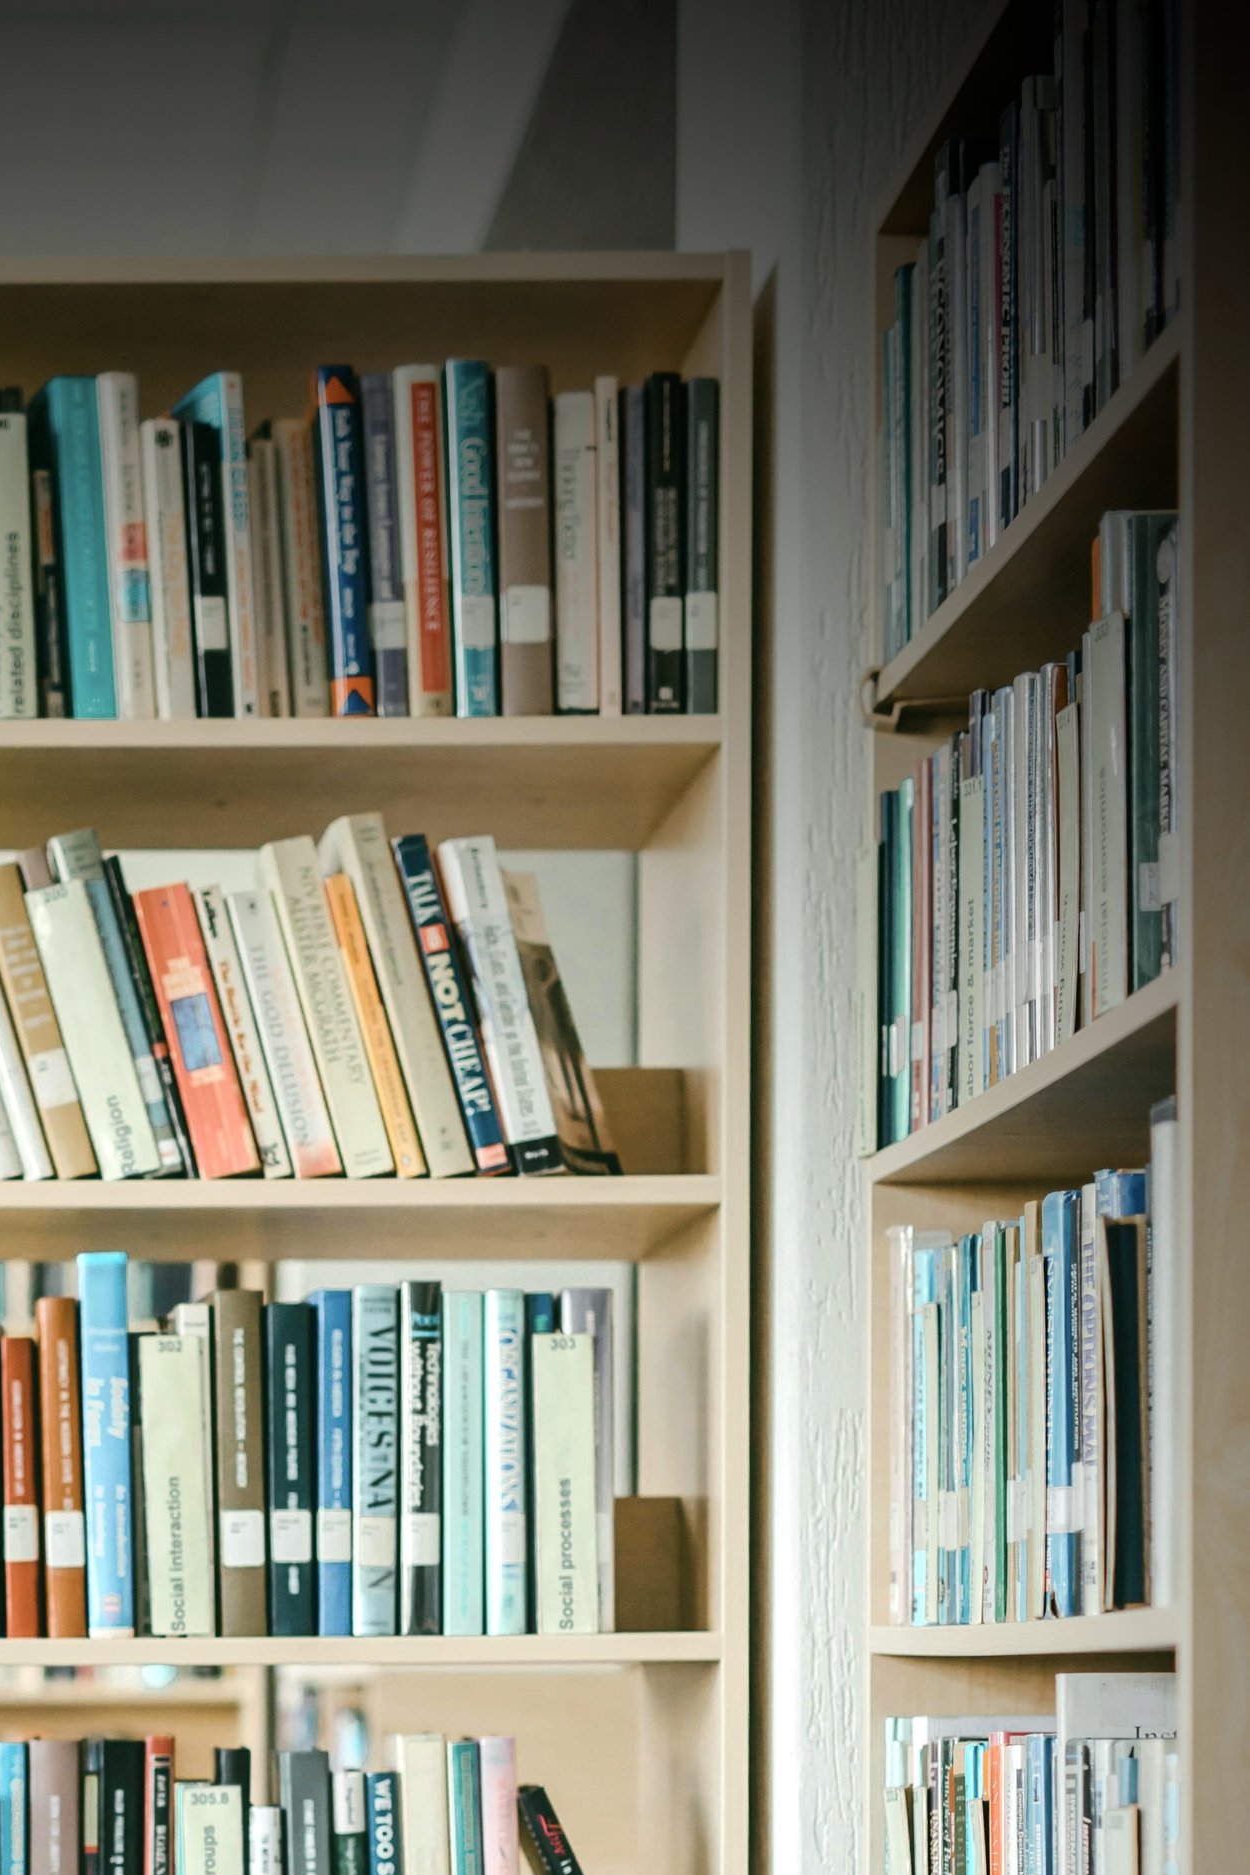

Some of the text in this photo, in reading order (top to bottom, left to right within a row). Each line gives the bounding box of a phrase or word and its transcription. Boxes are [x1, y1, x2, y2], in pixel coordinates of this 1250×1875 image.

[6, 531, 24, 714] related disciplines
[321, 957, 365, 1086] COMMENTARY
[407, 871, 492, 1117] TALK NOT CHEAP!
[106, 1095, 137, 1174] Religion
[260, 991, 284, 1038] GOD
[273, 1047, 311, 1147] DELUSION
[367, 1325, 394, 1449] VOICES
[168, 1476, 187, 1632] Social interaction
[558, 1479, 575, 1630] Social processes
[374, 1779, 392, 1810] WE
[376, 1813, 393, 1860] TOO
